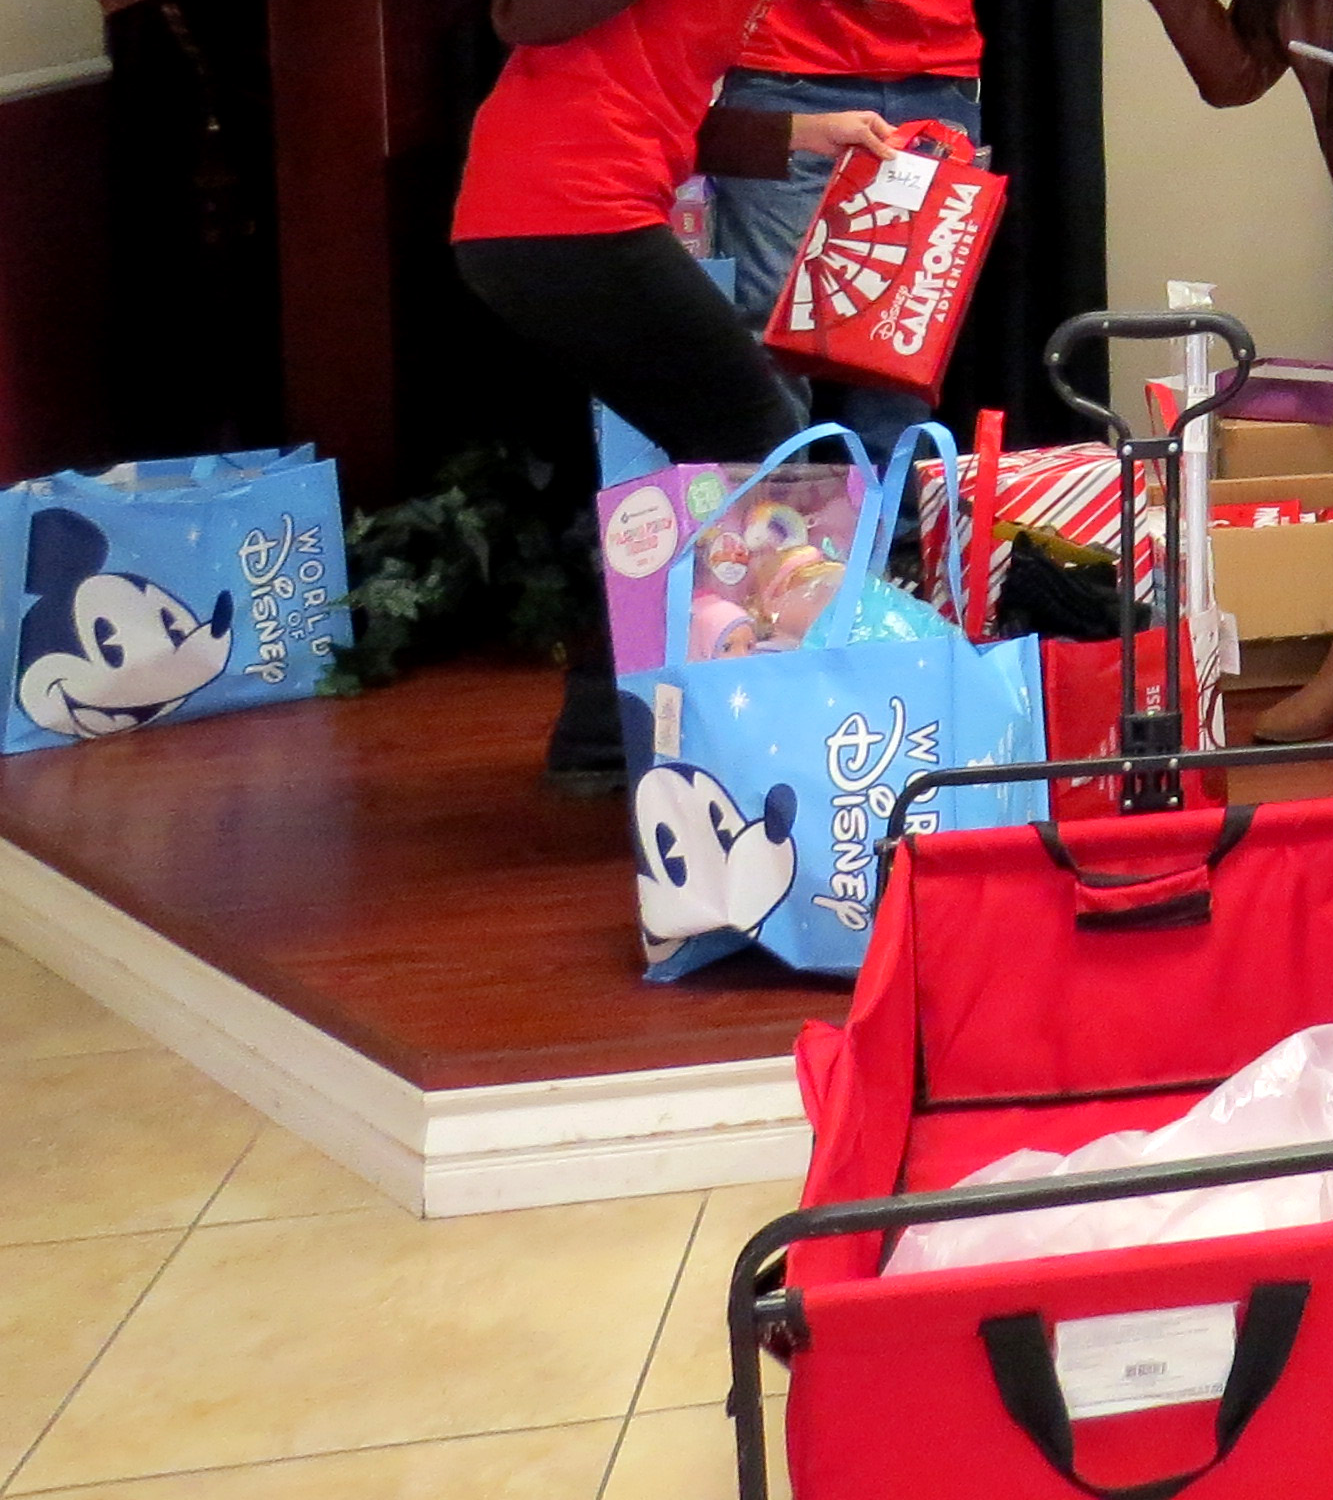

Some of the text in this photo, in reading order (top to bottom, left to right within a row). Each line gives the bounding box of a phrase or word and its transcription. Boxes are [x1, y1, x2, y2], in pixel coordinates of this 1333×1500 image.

[886, 170, 921, 189] 342
[893, 184, 983, 356] CALIFORNIA
[935, 220, 979, 323] ADVENTURE
[287, 610, 306, 640] OF
[296, 524, 333, 656] WORLD
[905, 719, 940, 836] WOR
